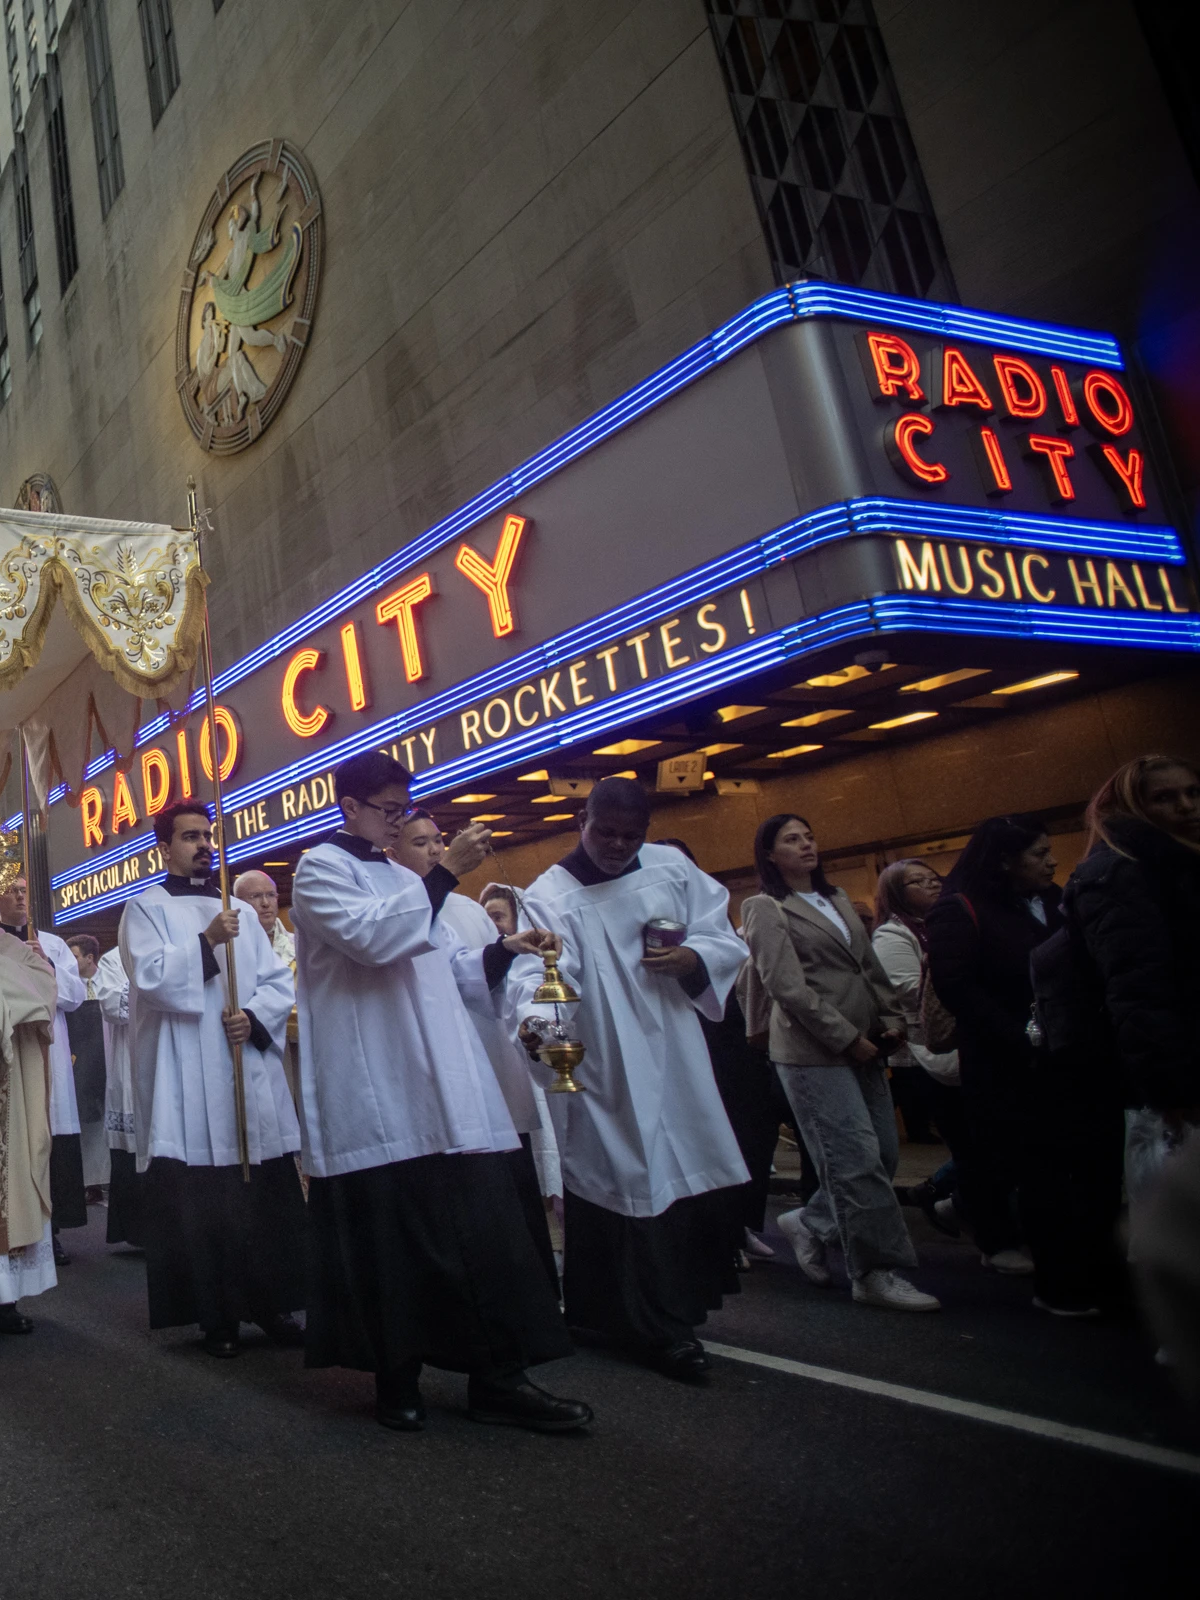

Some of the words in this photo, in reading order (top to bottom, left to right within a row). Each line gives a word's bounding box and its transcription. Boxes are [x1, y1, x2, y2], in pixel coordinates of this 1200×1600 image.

[867, 331, 1134, 437] RADIO
[894, 413, 1146, 508] CITY
[896, 539, 1056, 603] MUSIC
[1068, 558, 1190, 613] HALL
[81, 706, 239, 847] RADIO
[282, 514, 527, 738] CITY
[61, 857, 140, 908] SPECTACULAR
[232, 801, 270, 839] THE
[281, 772, 335, 820] RADI
[377, 727, 436, 773] TY
